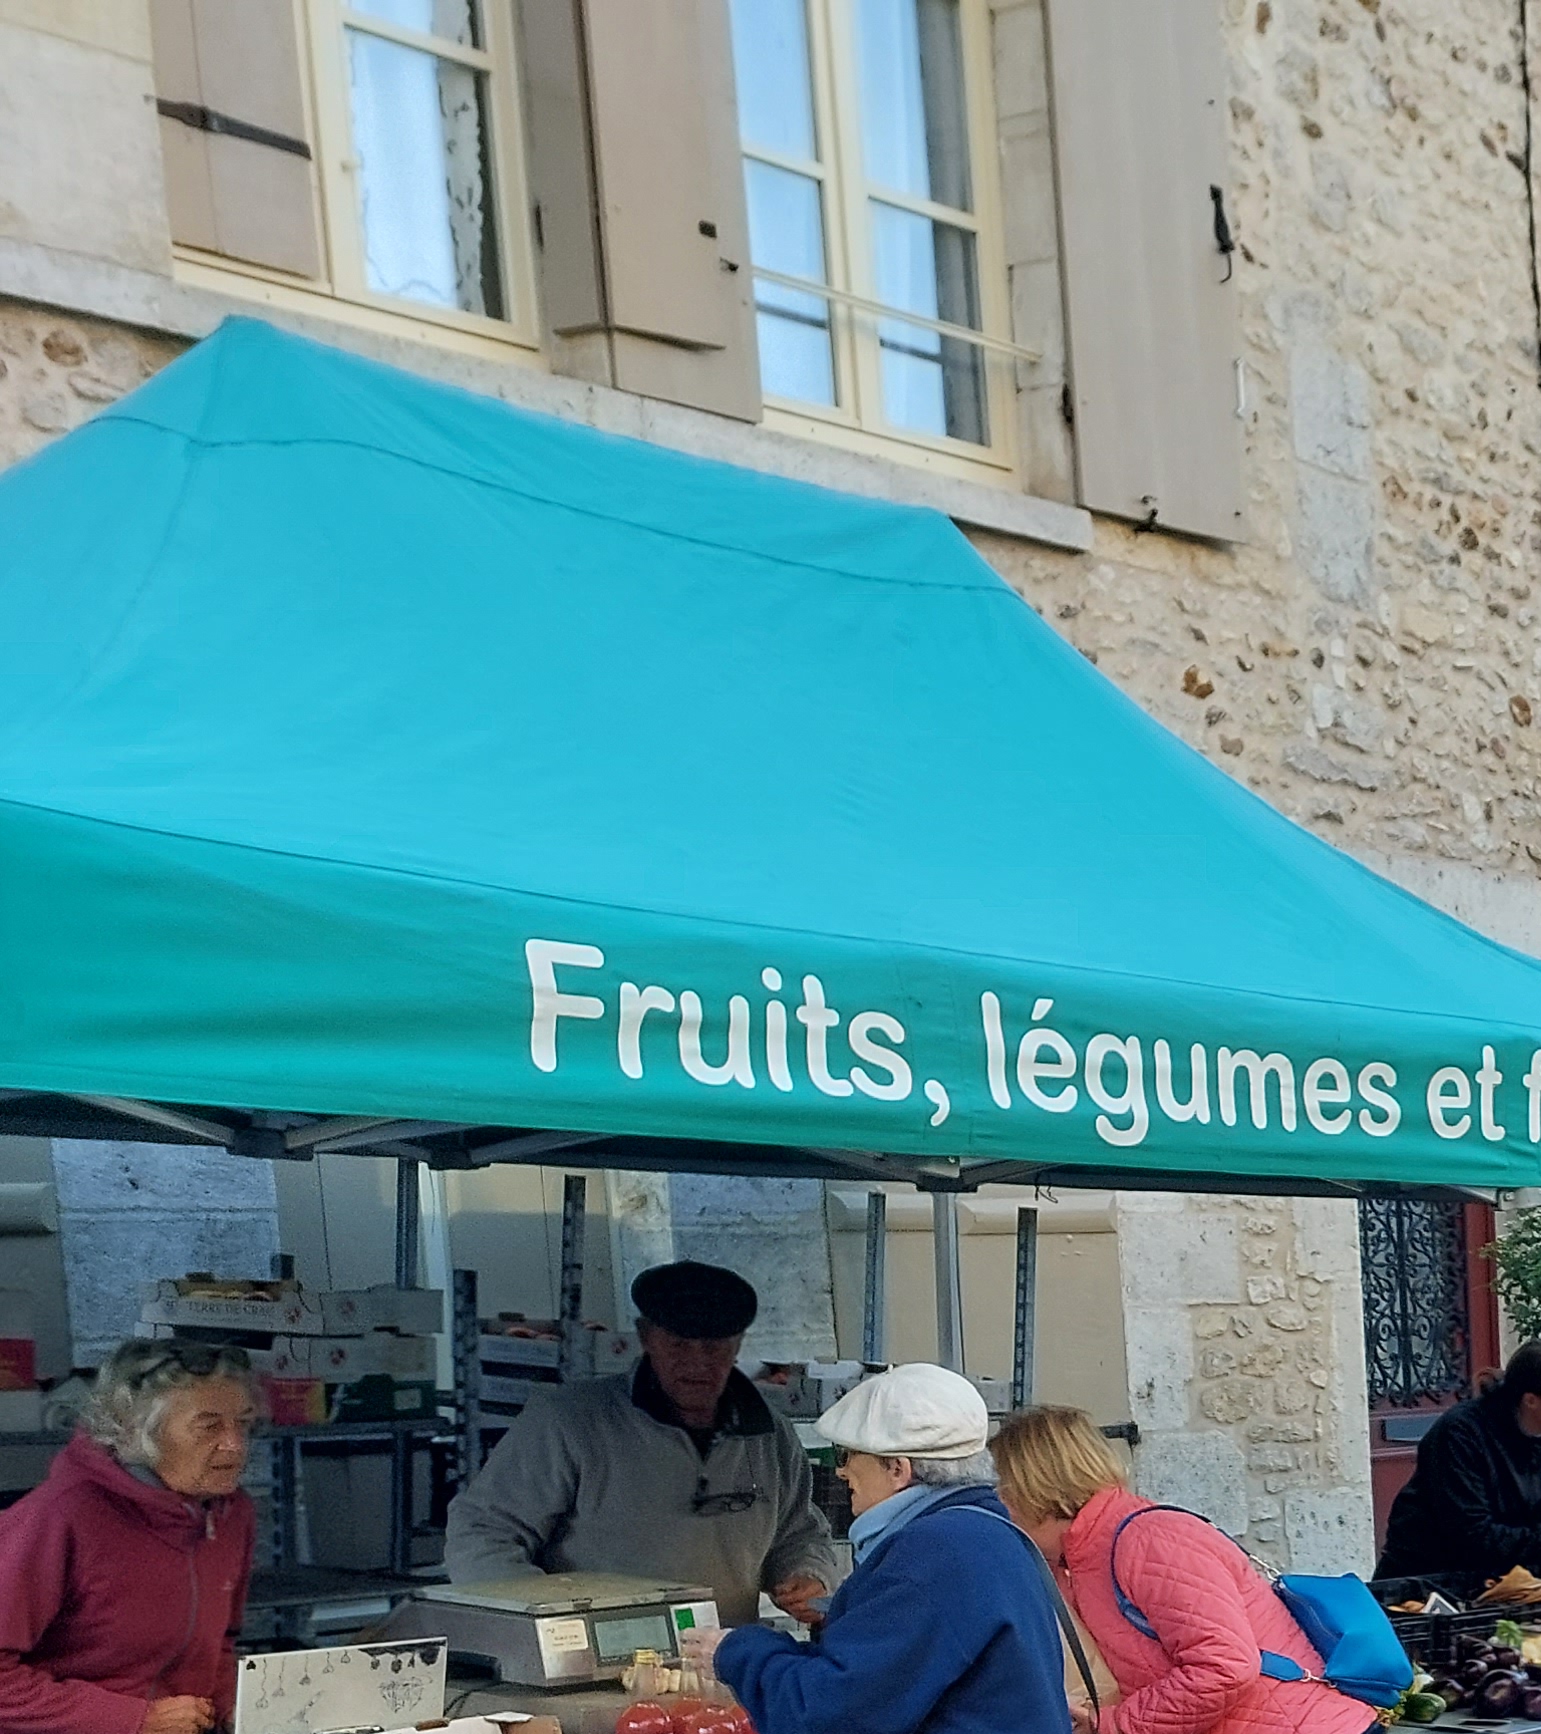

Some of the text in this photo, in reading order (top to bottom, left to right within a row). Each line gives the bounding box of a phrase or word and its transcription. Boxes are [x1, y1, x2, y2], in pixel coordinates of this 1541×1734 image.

[525, 939, 950, 1127] Fruits,
[981, 991, 1401, 1147] légumes
[1426, 1045, 1506, 1141] et
